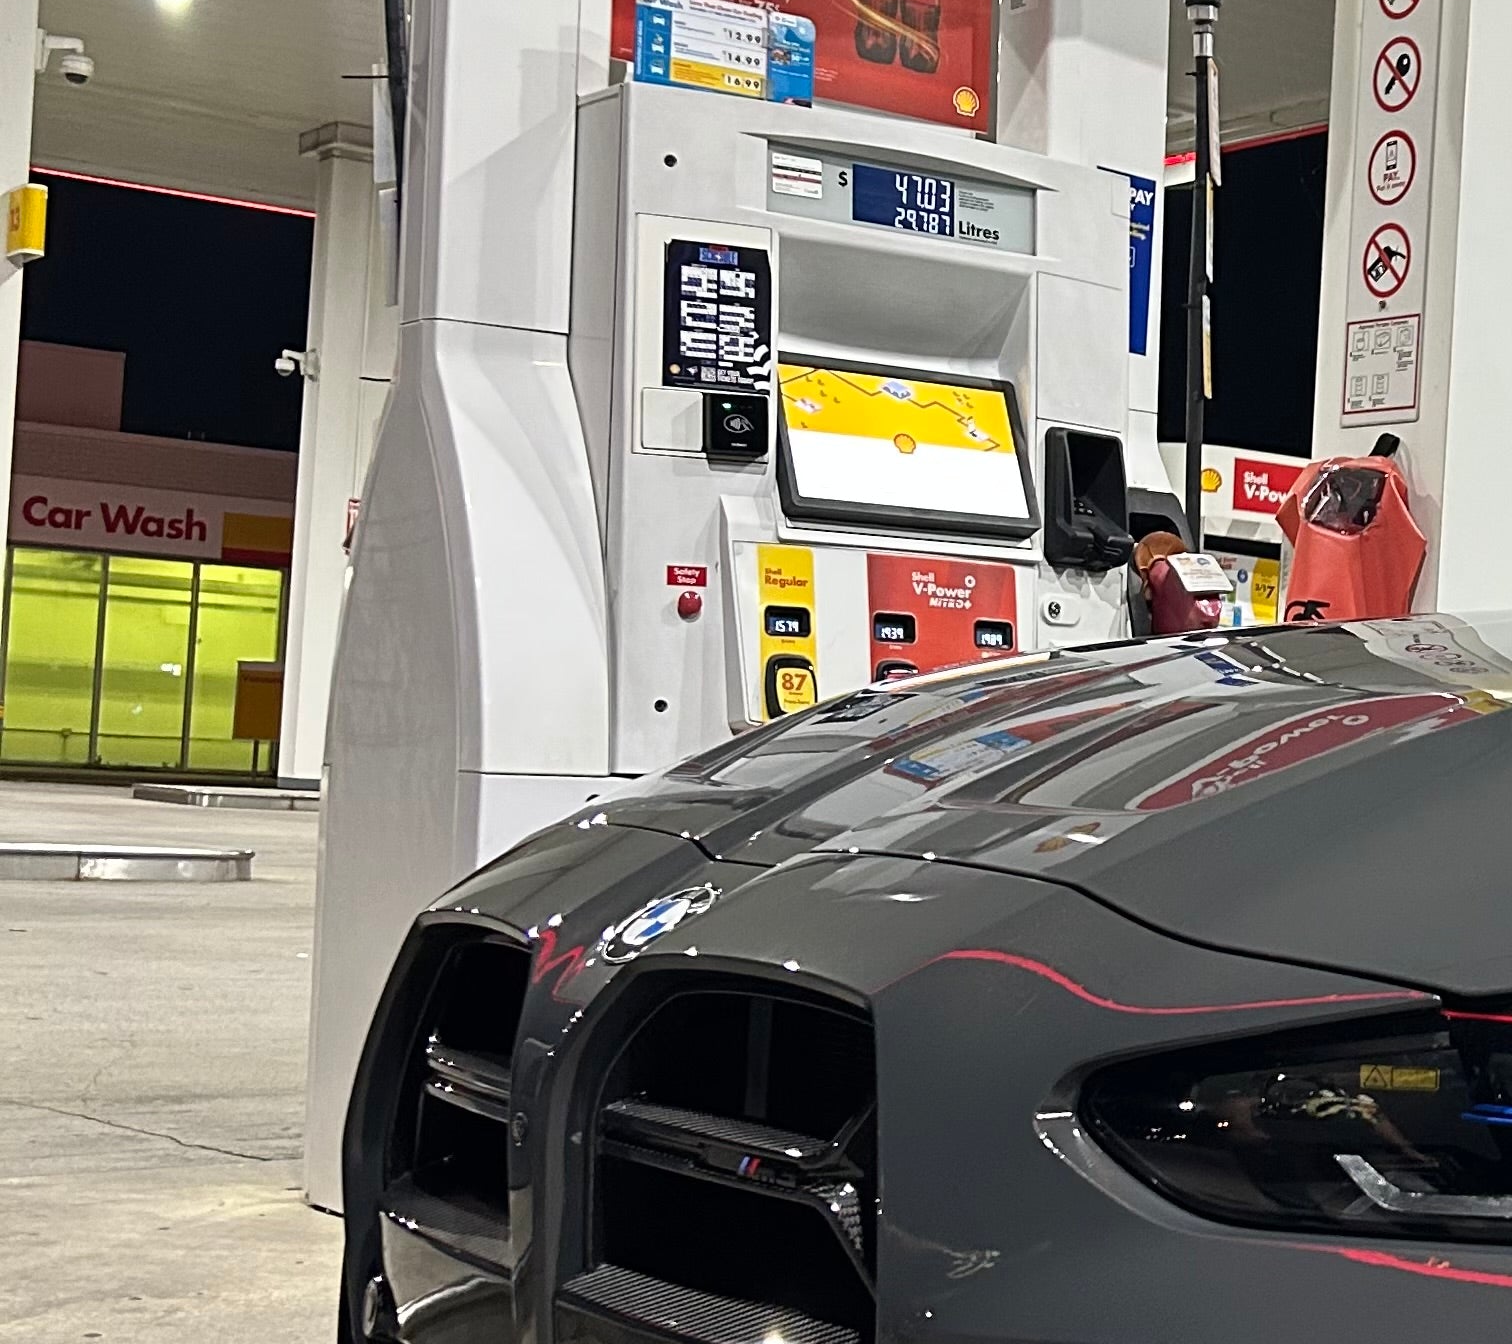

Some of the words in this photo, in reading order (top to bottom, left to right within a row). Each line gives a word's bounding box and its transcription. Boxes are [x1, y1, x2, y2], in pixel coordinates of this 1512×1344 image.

[838, 170, 848, 187] $
[958, 220, 1000, 240] Litres
[1243, 471, 1269, 485] Shell
[22, 495, 91, 531] Car
[100, 502, 207, 542] Wash
[673, 567, 700, 578] Safety
[677, 575, 697, 585] Stop
[911, 571, 935, 583] Shell
[765, 574, 808, 588] Regular
[912, 582, 972, 599] V-Power
[781, 673, 807, 691] 87
